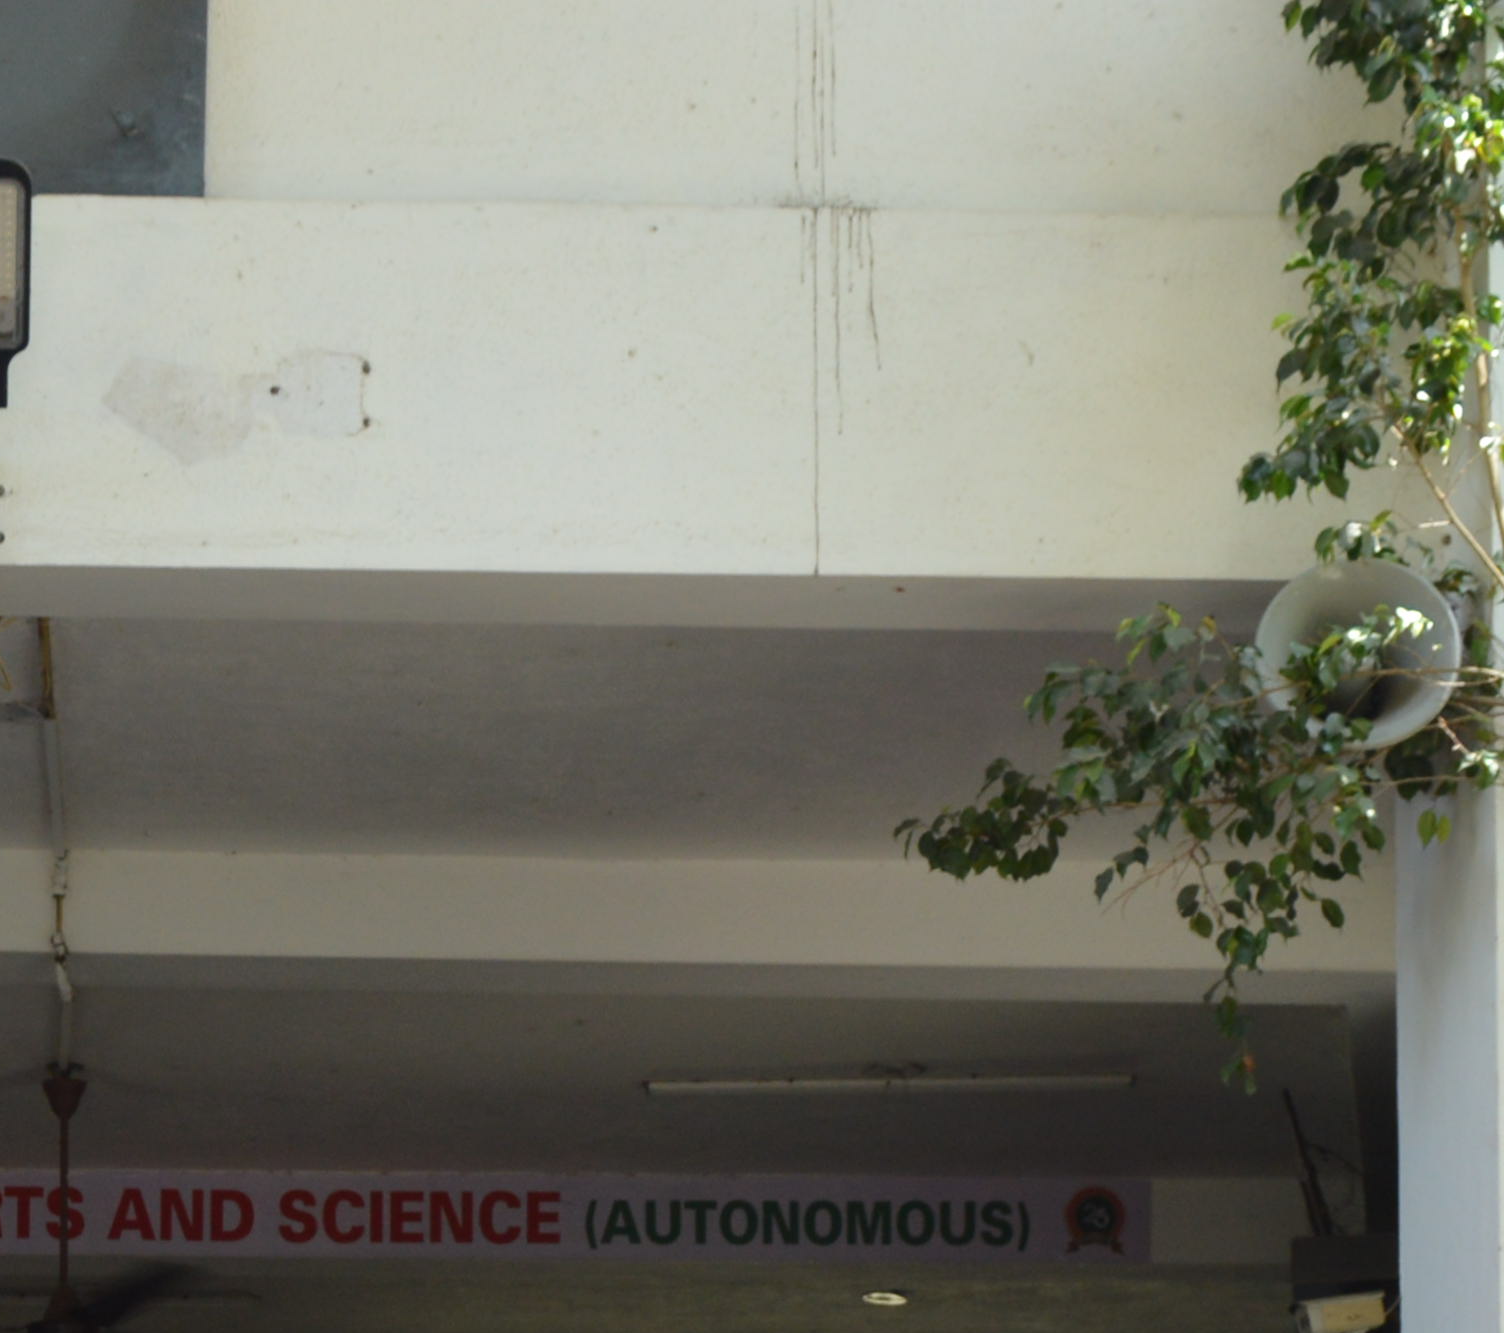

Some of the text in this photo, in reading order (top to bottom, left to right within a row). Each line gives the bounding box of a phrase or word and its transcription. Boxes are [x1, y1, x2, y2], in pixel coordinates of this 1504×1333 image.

[108, 1189, 254, 1243] AND
[277, 1190, 561, 1246] SCIENCE
[584, 1196, 1030, 1252] (AUTONOMOUS)
